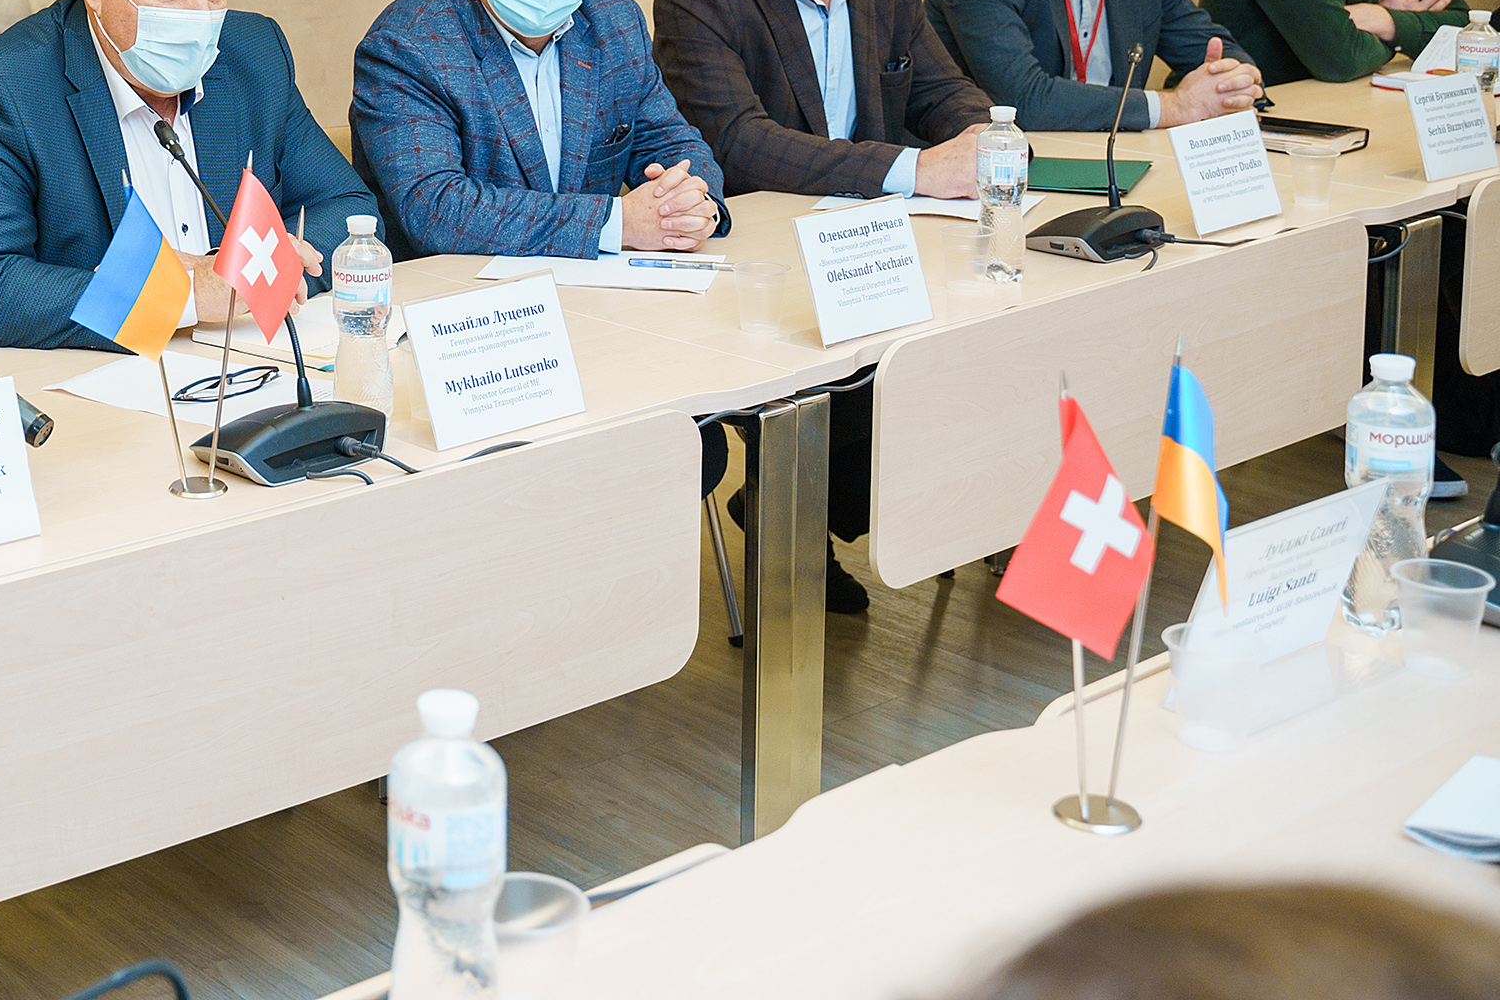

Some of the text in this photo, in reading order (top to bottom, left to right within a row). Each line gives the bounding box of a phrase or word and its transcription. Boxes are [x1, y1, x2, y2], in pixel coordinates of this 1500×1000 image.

[1189, 129, 1254, 149] Володимир Дудко
[1199, 159, 1262, 180] Volodymyr Dudko
[819, 218, 903, 243] Олександр Нечаєв
[827, 255, 913, 283] Oleksandr Nechaiev
[431, 304, 544, 337] Михайло Луценко
[450, 331, 493, 347] Генеральний
[495, 324, 524, 337] директор
[478, 337, 518, 354] транспортна
[445, 358, 558, 395] Mykhailo Lutsenko
[463, 388, 553, 415] Vinnytsia Transport Company
[472, 378, 540, 402] Director General of ME
[1311, 517, 1348, 542] Санті
[1248, 570, 1317, 607] Luigi Santi
